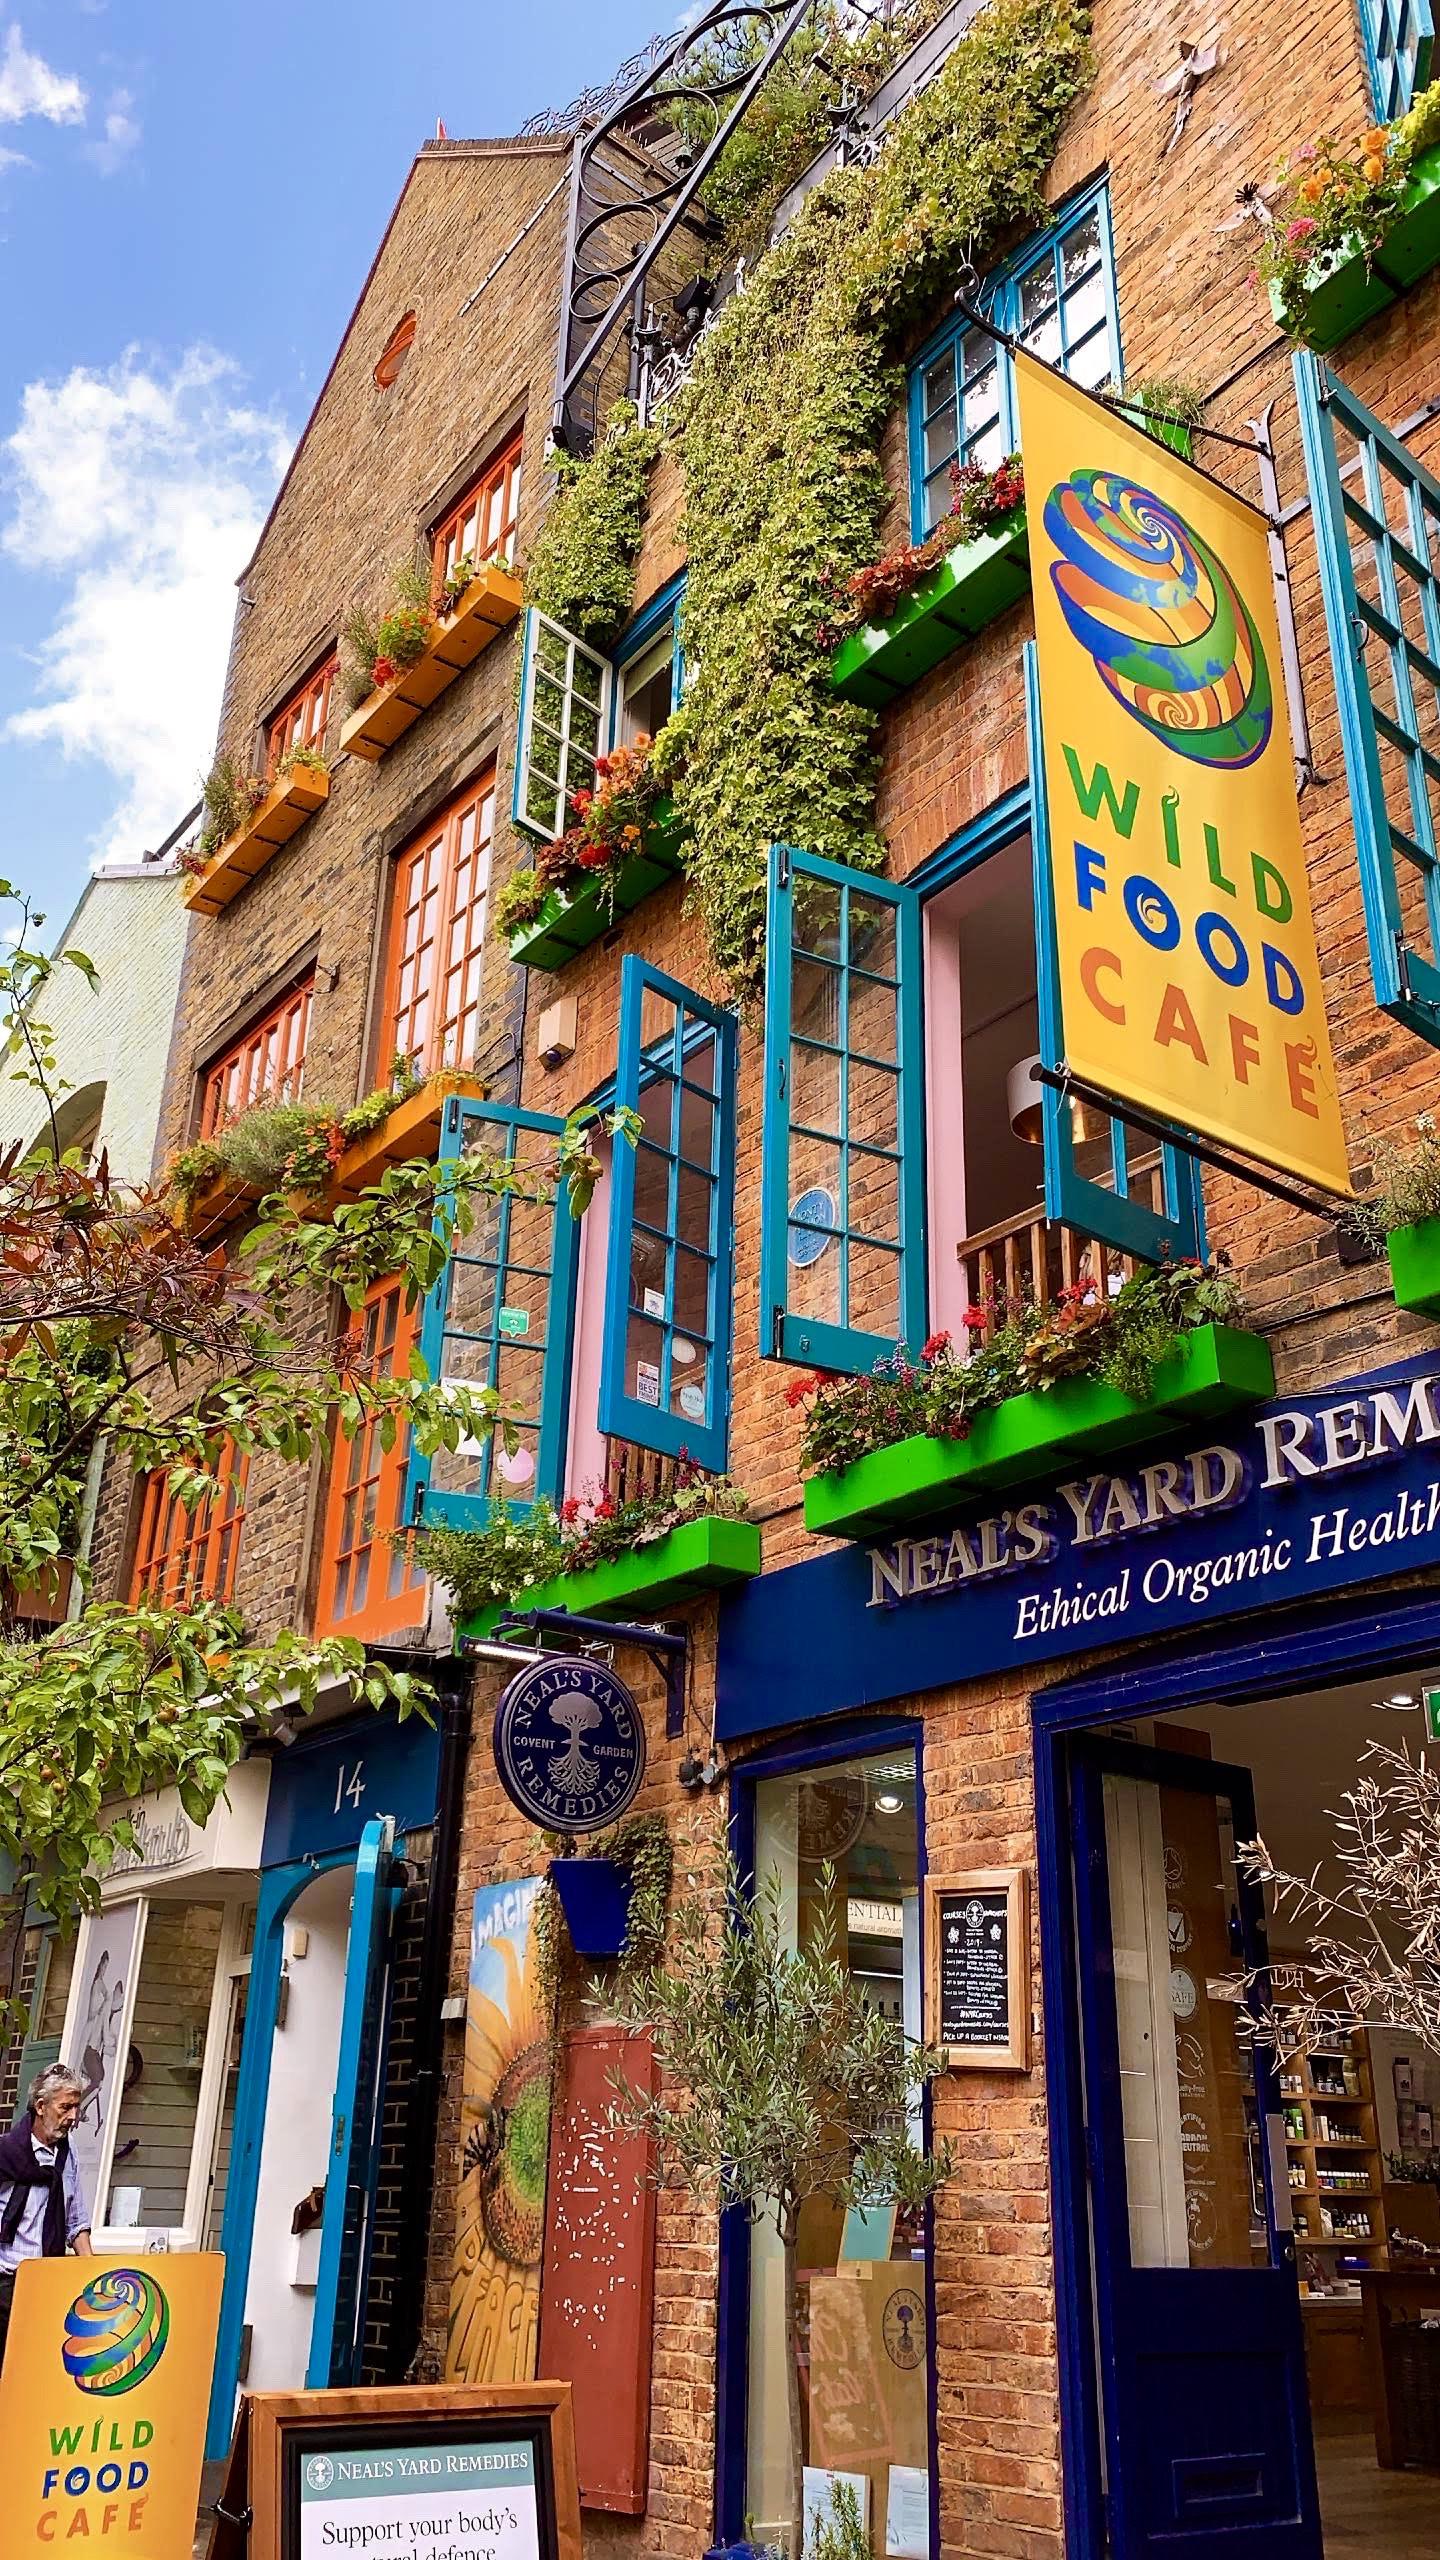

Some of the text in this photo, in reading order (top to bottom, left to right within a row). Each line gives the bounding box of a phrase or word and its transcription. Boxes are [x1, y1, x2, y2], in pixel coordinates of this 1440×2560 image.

[1074, 841, 1305, 1016] FOOD
[1056, 1445, 1245, 1547] YARD
[1013, 1569, 1130, 1640] Ethical
[1142, 1528, 1292, 1604] Organic
[590, 1674, 633, 1740] YARD
[513, 1735, 634, 1759] COVENT GARDEN
[334, 1760, 366, 1814] 14
[517, 1756, 630, 1816] REMEDIES
[1182, 2142, 1211, 2153] EUTRAL
[49, 2415, 154, 2457] WILD
[42, 2461, 149, 2500] FOOD
[397, 2457, 443, 2477] YARD
[446, 2452, 529, 2475] REMEDIES
[322, 2520, 405, 2549] Support
[409, 2518, 453, 2544] your
